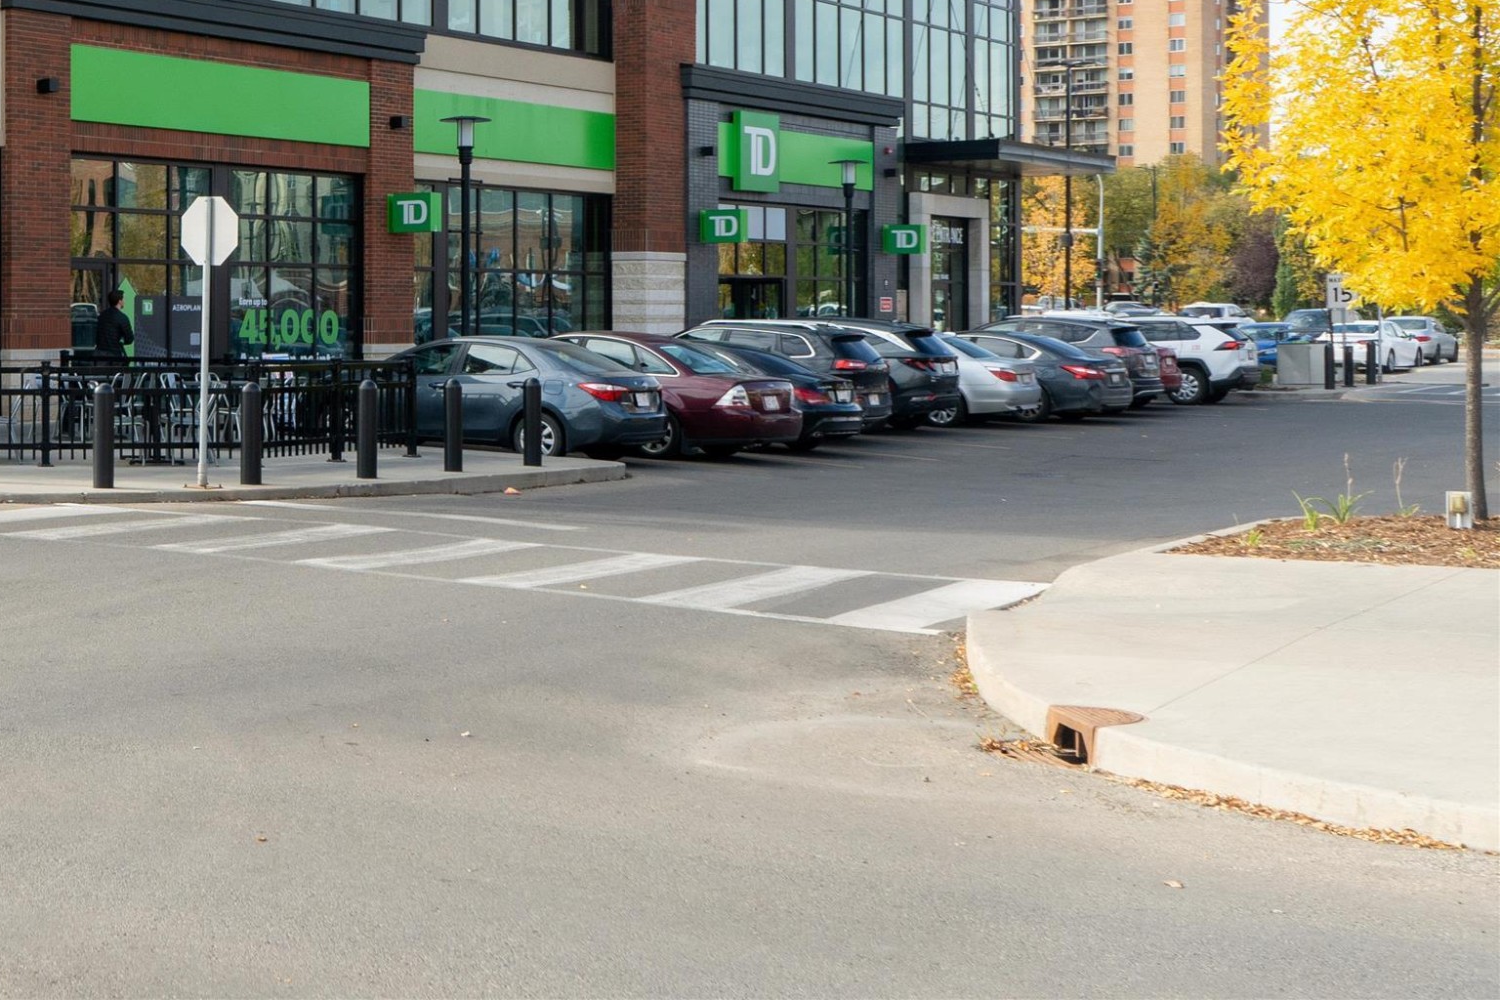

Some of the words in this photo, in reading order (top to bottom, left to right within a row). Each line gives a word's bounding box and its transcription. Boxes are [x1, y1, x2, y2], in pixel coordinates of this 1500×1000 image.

[743, 125, 776, 176] TD
[397, 199, 428, 225] TD
[708, 215, 738, 237] TD
[890, 229, 918, 249] TD
[238, 297, 253, 306] Earn
[1332, 287, 1353, 303] 15
[238, 308, 339, 350] 45,000
